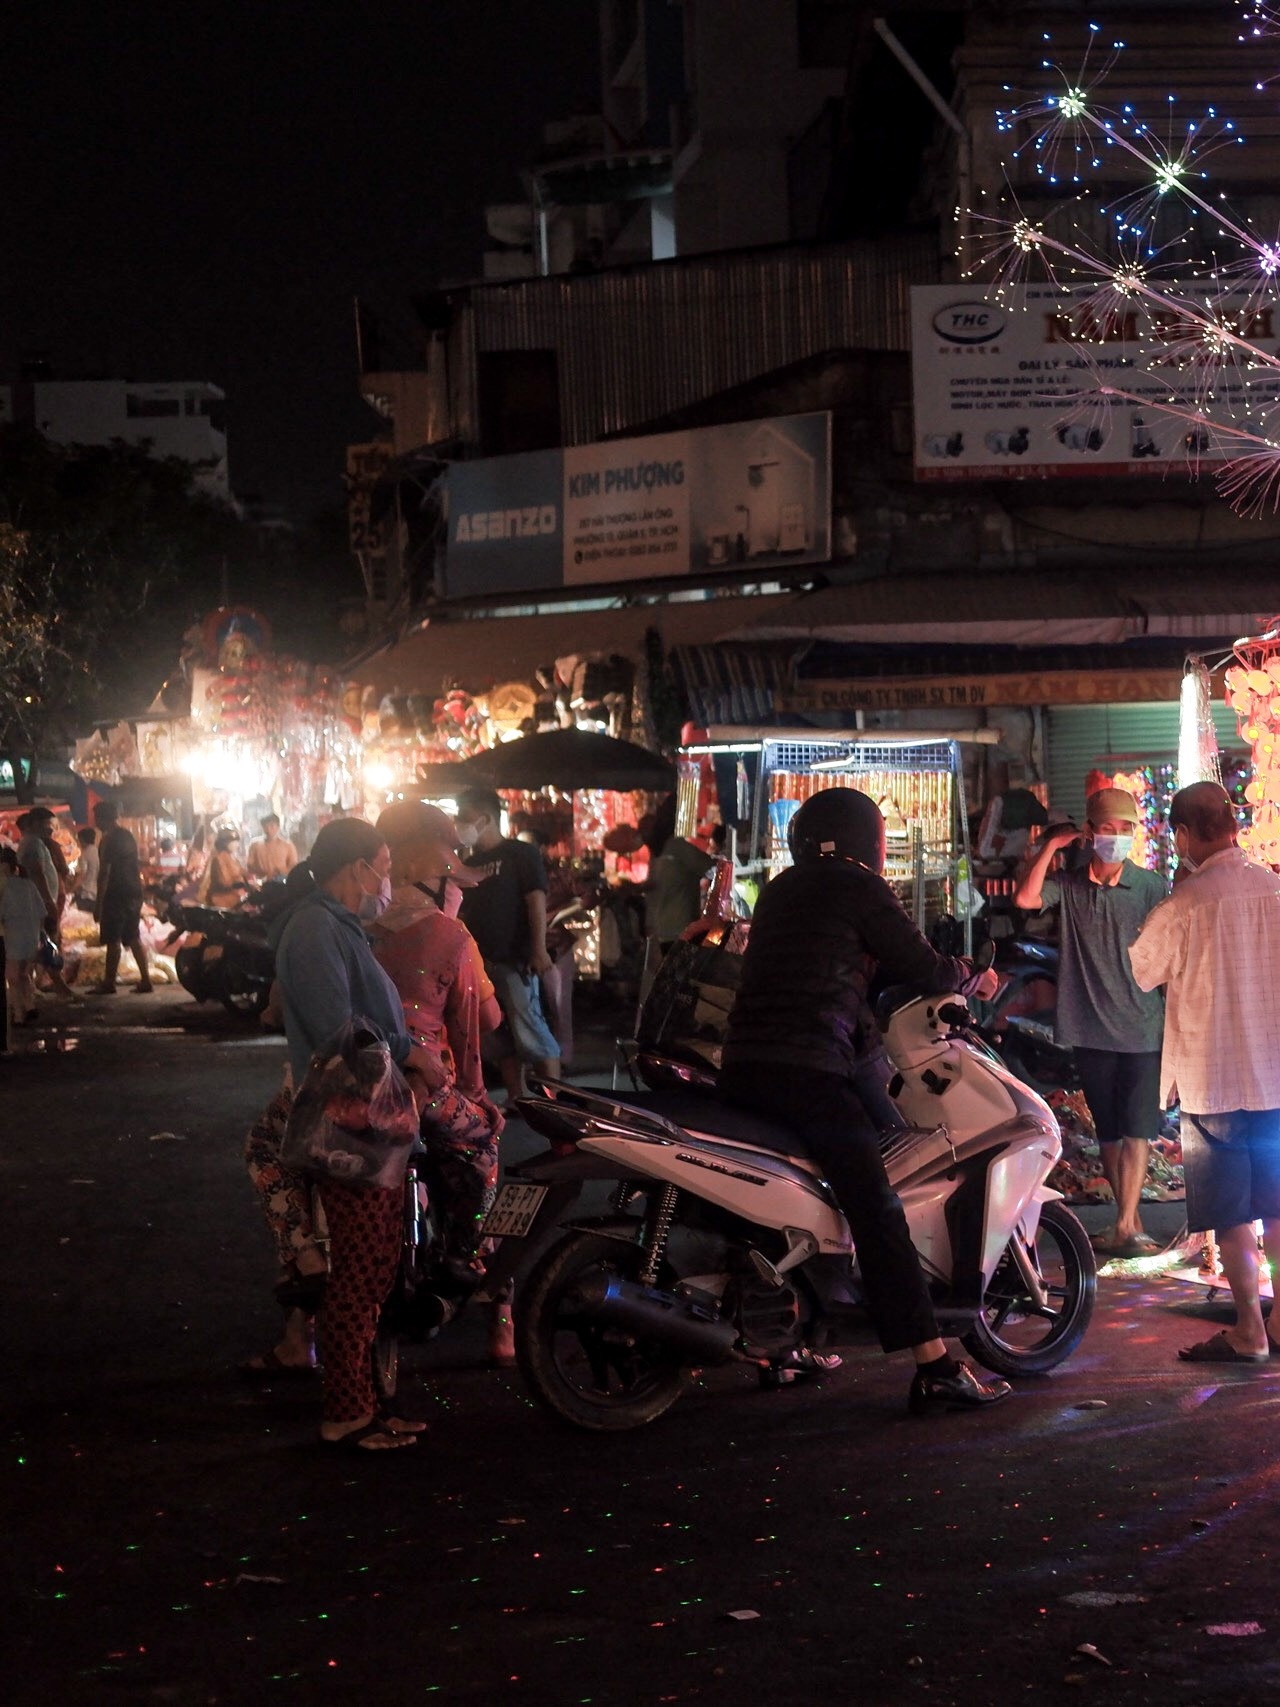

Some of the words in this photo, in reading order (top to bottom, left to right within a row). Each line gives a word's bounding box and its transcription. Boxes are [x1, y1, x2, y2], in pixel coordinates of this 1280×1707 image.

[951, 313, 990, 327] THC
[569, 472, 600, 498] KIM
[604, 459, 685, 496] PHƯỢNG
[877, 688, 890, 705] TY
[930, 686, 945, 704] SX
[949, 685, 966, 703] TM
